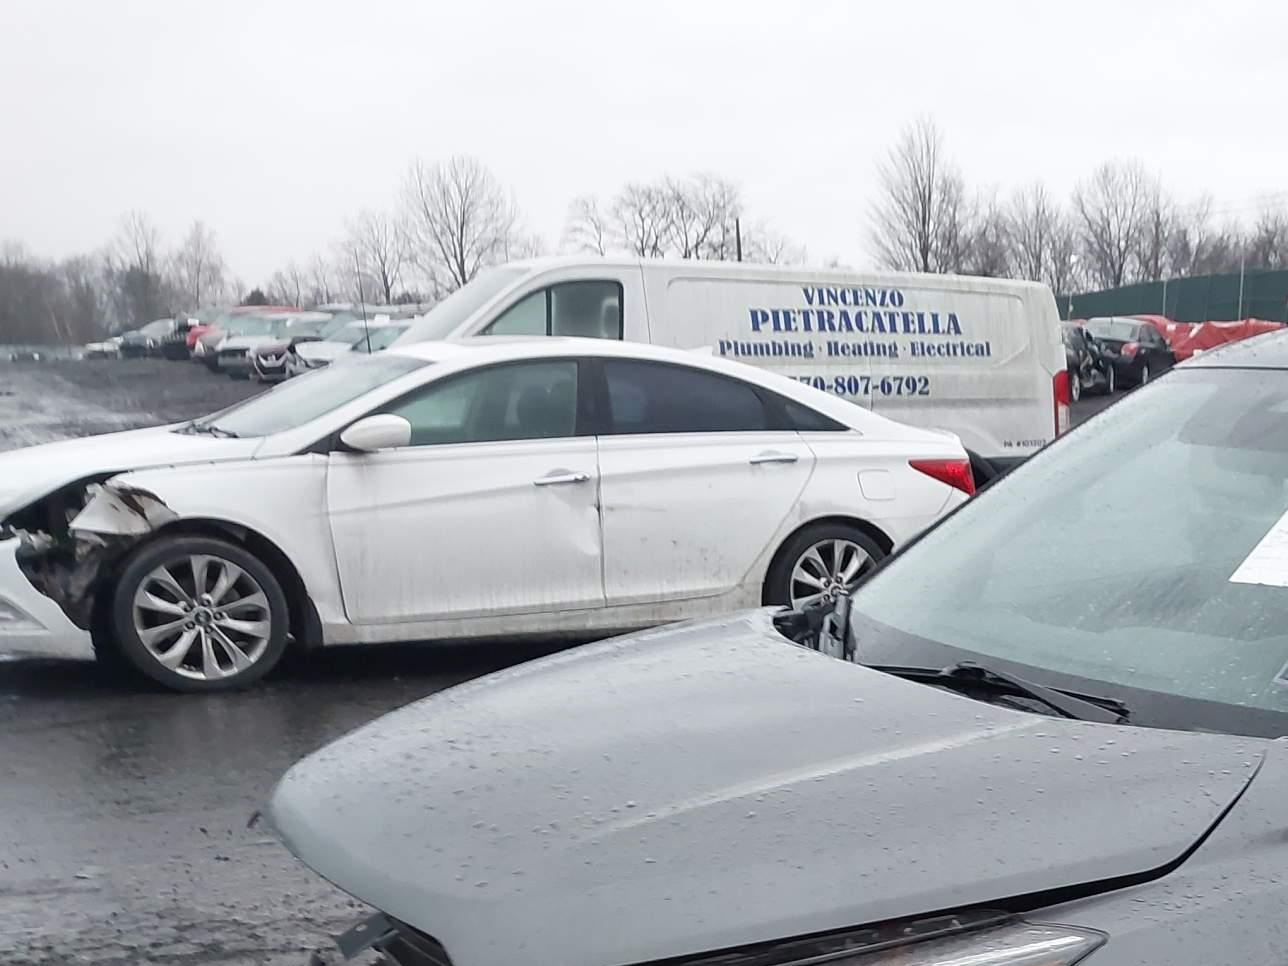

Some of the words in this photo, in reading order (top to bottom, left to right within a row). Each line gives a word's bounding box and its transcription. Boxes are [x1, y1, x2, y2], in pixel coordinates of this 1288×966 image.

[802, 287, 905, 308] VINCENZO
[749, 308, 963, 336] PIETRACATELLA
[718, 339, 815, 359] Plumbing
[826, 340, 899, 359] Heating
[910, 341, 992, 358] Electrical
